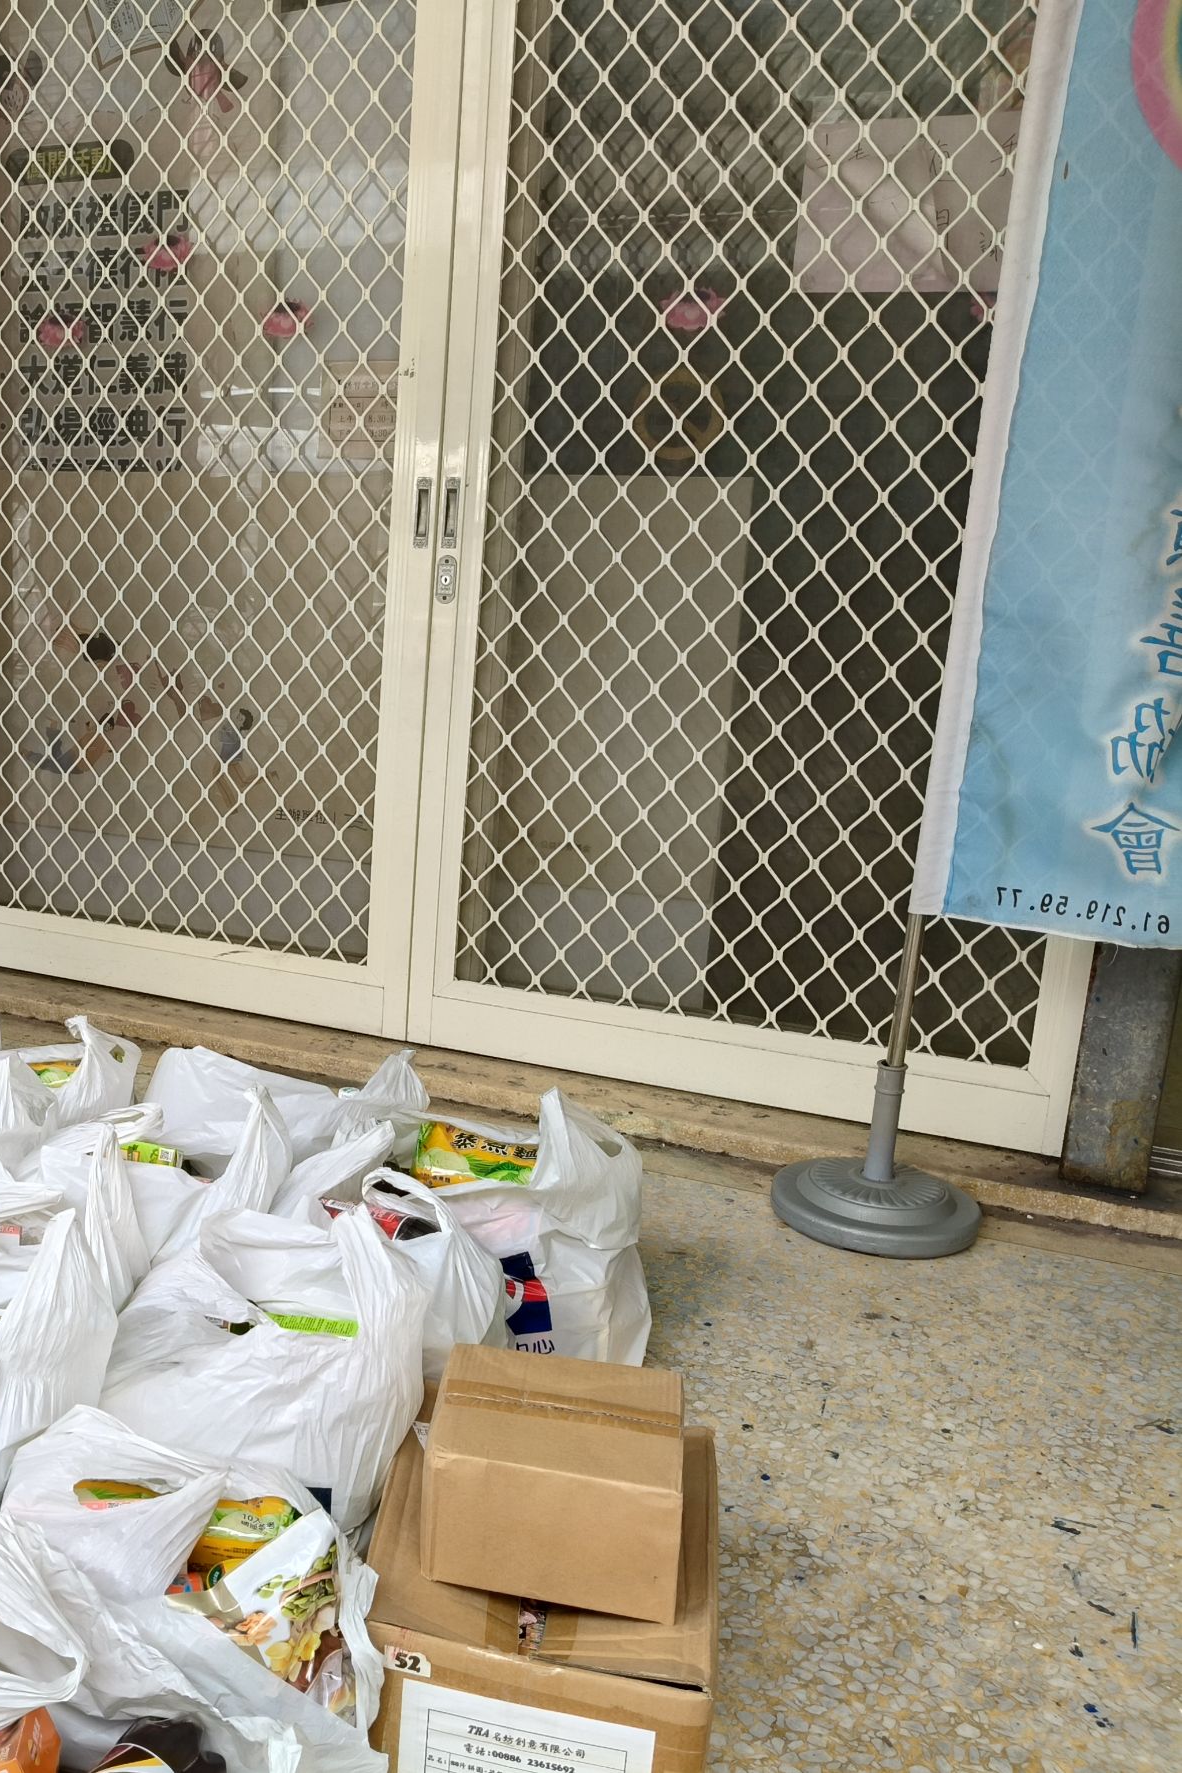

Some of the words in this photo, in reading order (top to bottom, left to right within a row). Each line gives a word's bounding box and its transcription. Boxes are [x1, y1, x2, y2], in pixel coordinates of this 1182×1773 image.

[18, 247, 188, 293] 孟子德行
[394, 1652, 422, 1673] 52
[467, 1724, 490, 1739] TRA
